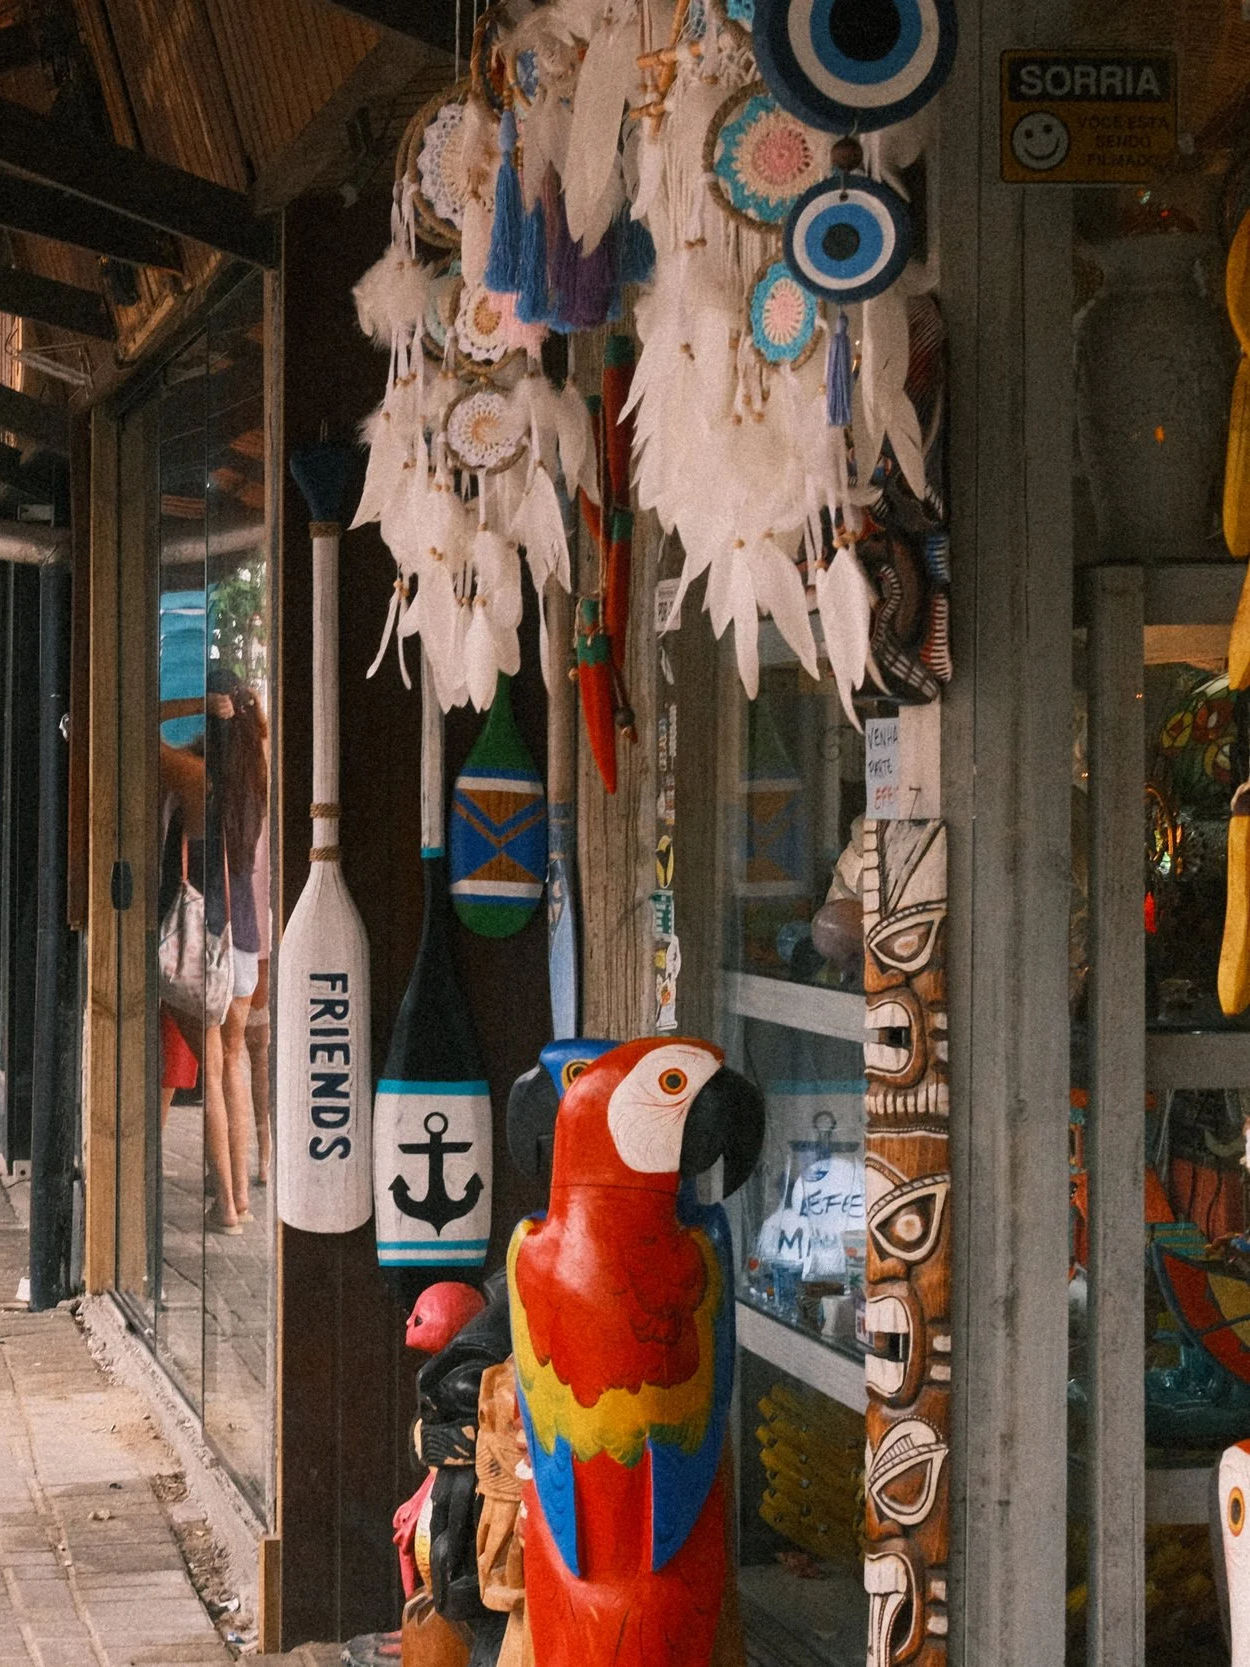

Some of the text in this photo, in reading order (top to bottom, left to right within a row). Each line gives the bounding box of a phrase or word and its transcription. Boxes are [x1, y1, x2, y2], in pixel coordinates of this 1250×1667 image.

[1019, 64, 1161, 96] SORRIA
[1095, 135, 1152, 149] SENDO
[309, 972, 352, 1161] FRIENDS
